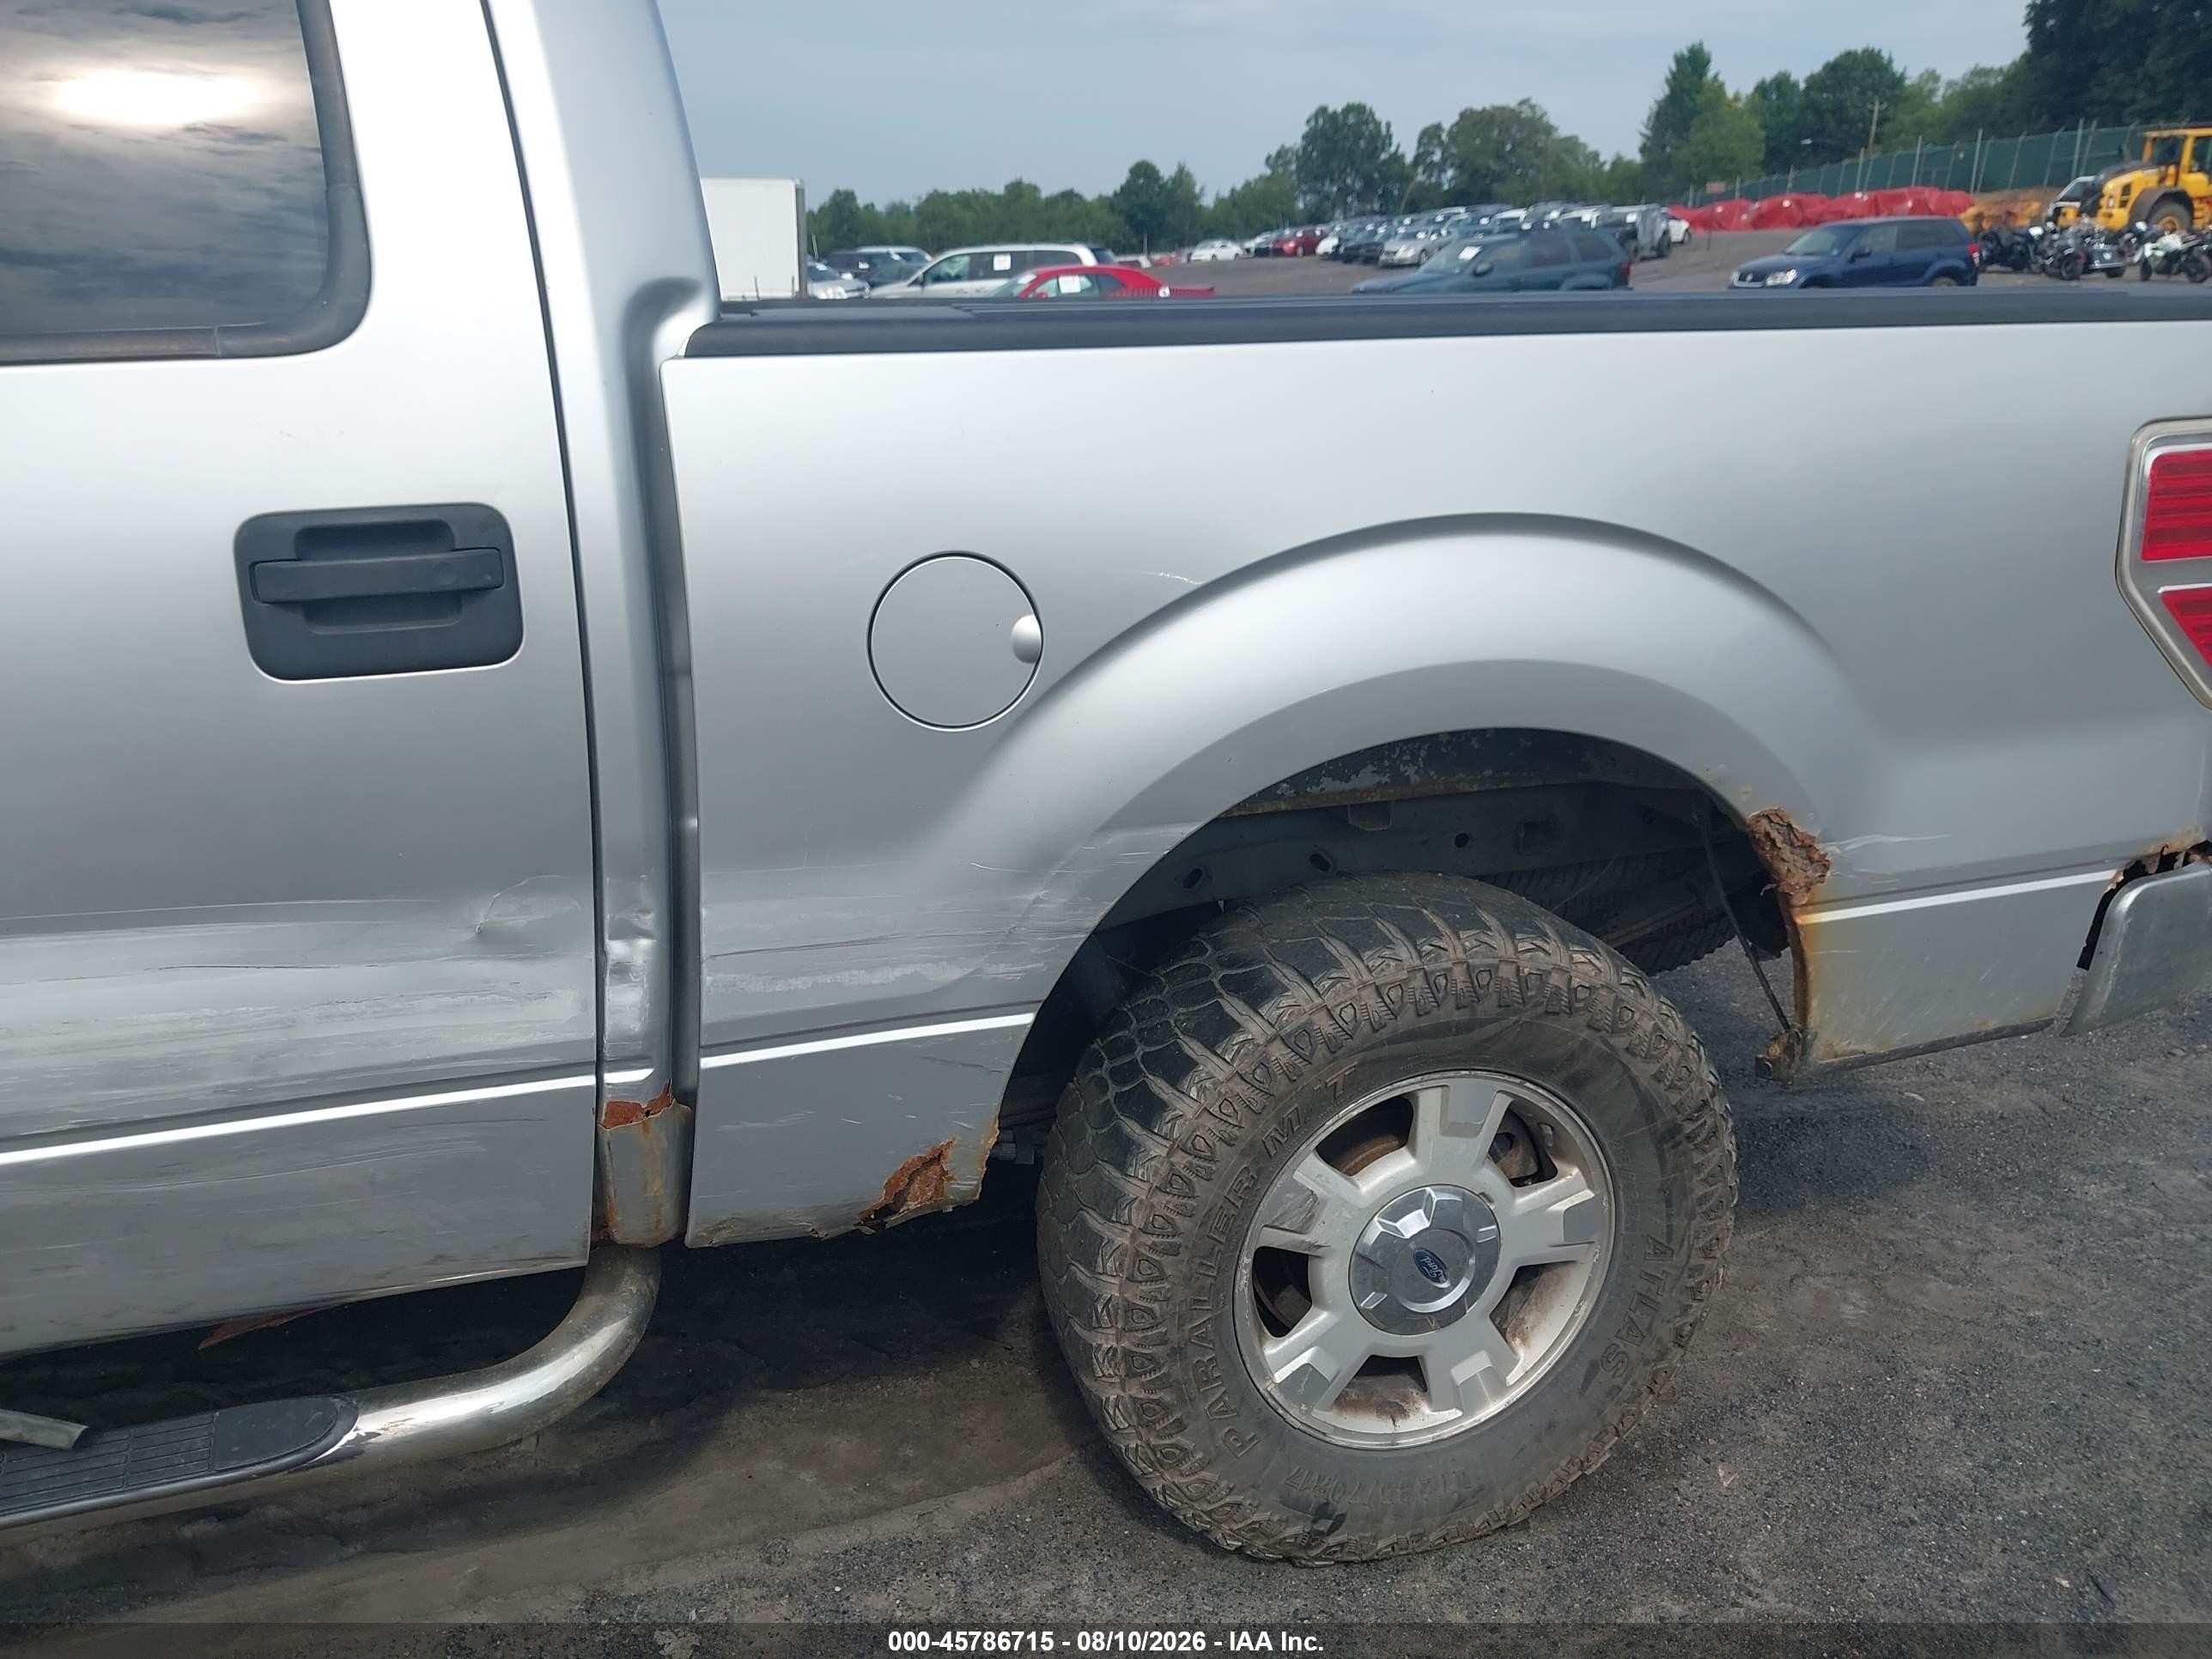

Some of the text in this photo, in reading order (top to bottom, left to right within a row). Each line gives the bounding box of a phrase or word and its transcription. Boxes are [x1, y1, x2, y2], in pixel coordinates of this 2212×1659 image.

[1187, 1163, 1261, 1460] PARALLER
[1421, 1255, 1443, 1278] Ford
[1600, 1233, 1676, 1379] ATLAS
